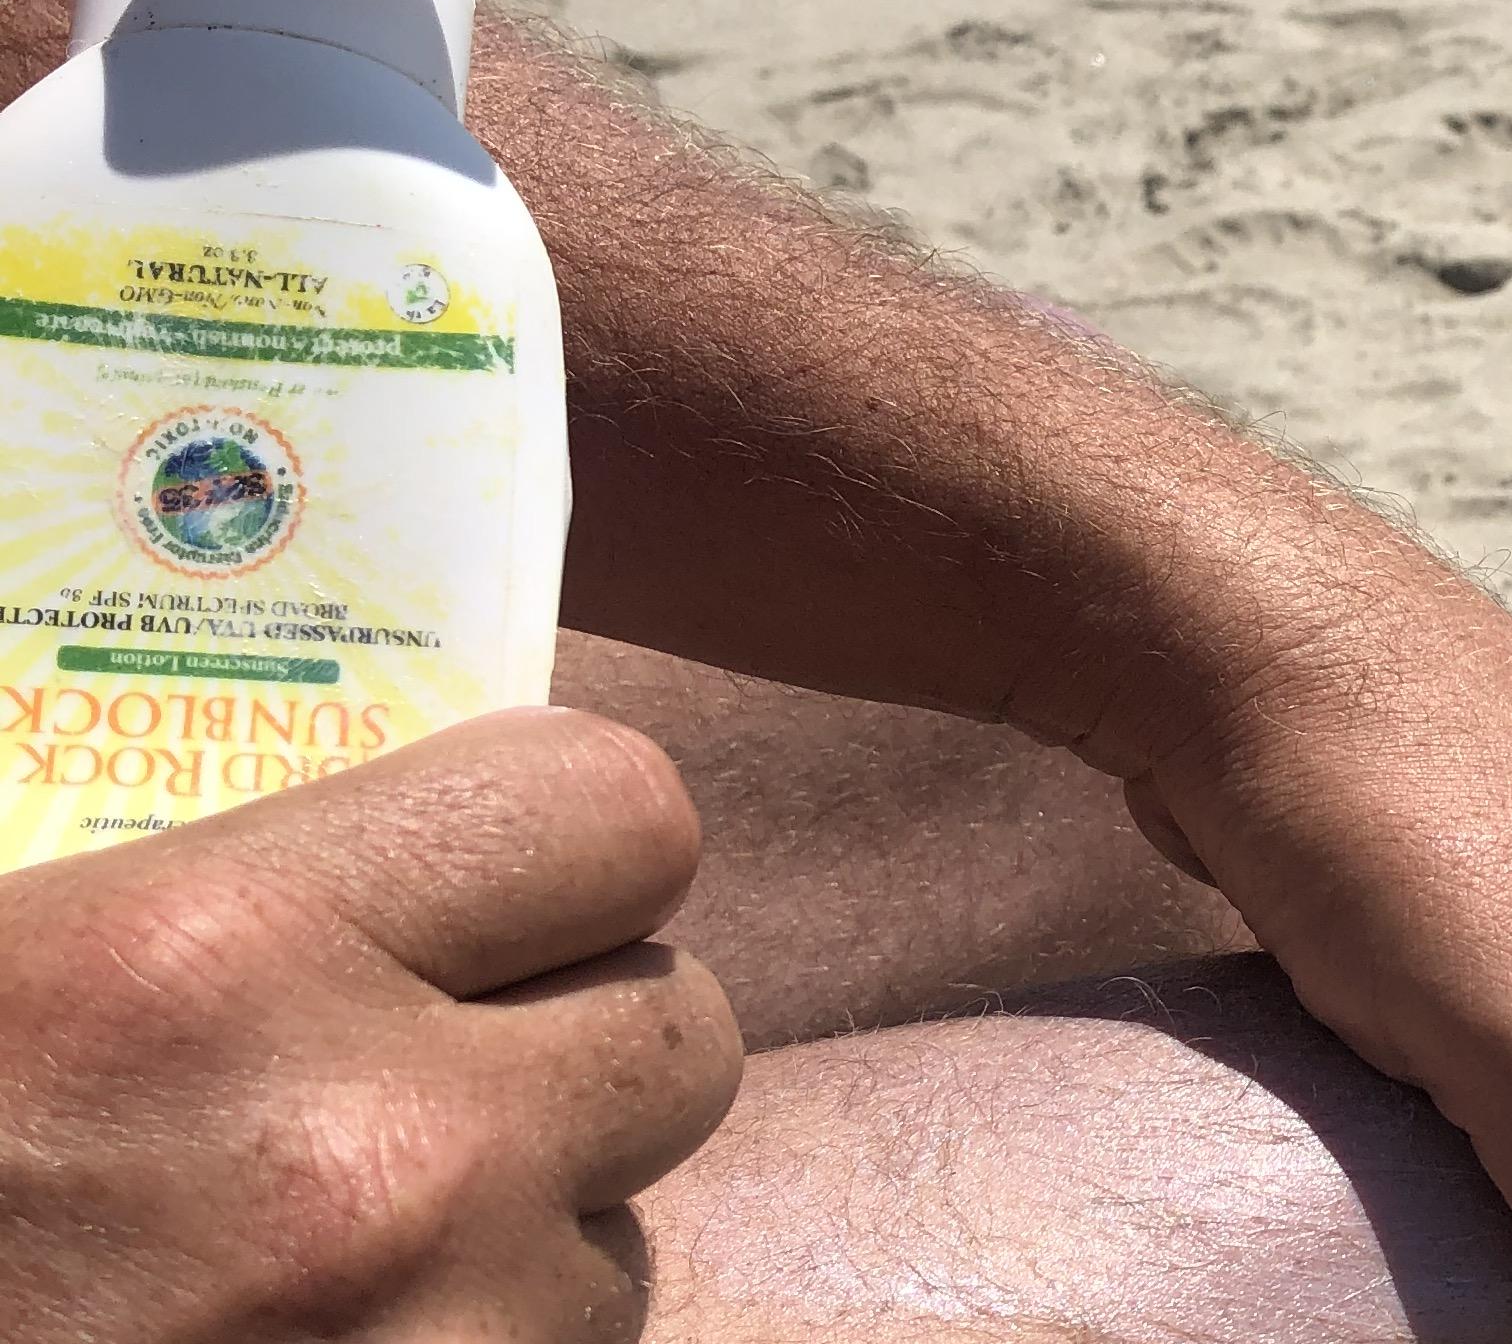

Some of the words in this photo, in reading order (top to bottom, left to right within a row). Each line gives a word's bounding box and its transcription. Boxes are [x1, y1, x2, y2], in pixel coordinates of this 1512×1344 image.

[203, 246, 223, 258] oz
[127, 260, 328, 295] ALL-NATURAL
[88, 590, 131, 608] SPF
[138, 592, 265, 615] SPECTRUM
[271, 600, 348, 620] BROAD
[140, 615, 256, 638] UVA/UVB
[264, 623, 442, 648] UNSURPASSED
[110, 652, 178, 672] Lotion
[186, 656, 289, 676] Sunscreen
[0, 686, 390, 749] SUNBLOCK
[16, 742, 205, 797] ROCK
[80, 814, 185, 834] rapeutic
